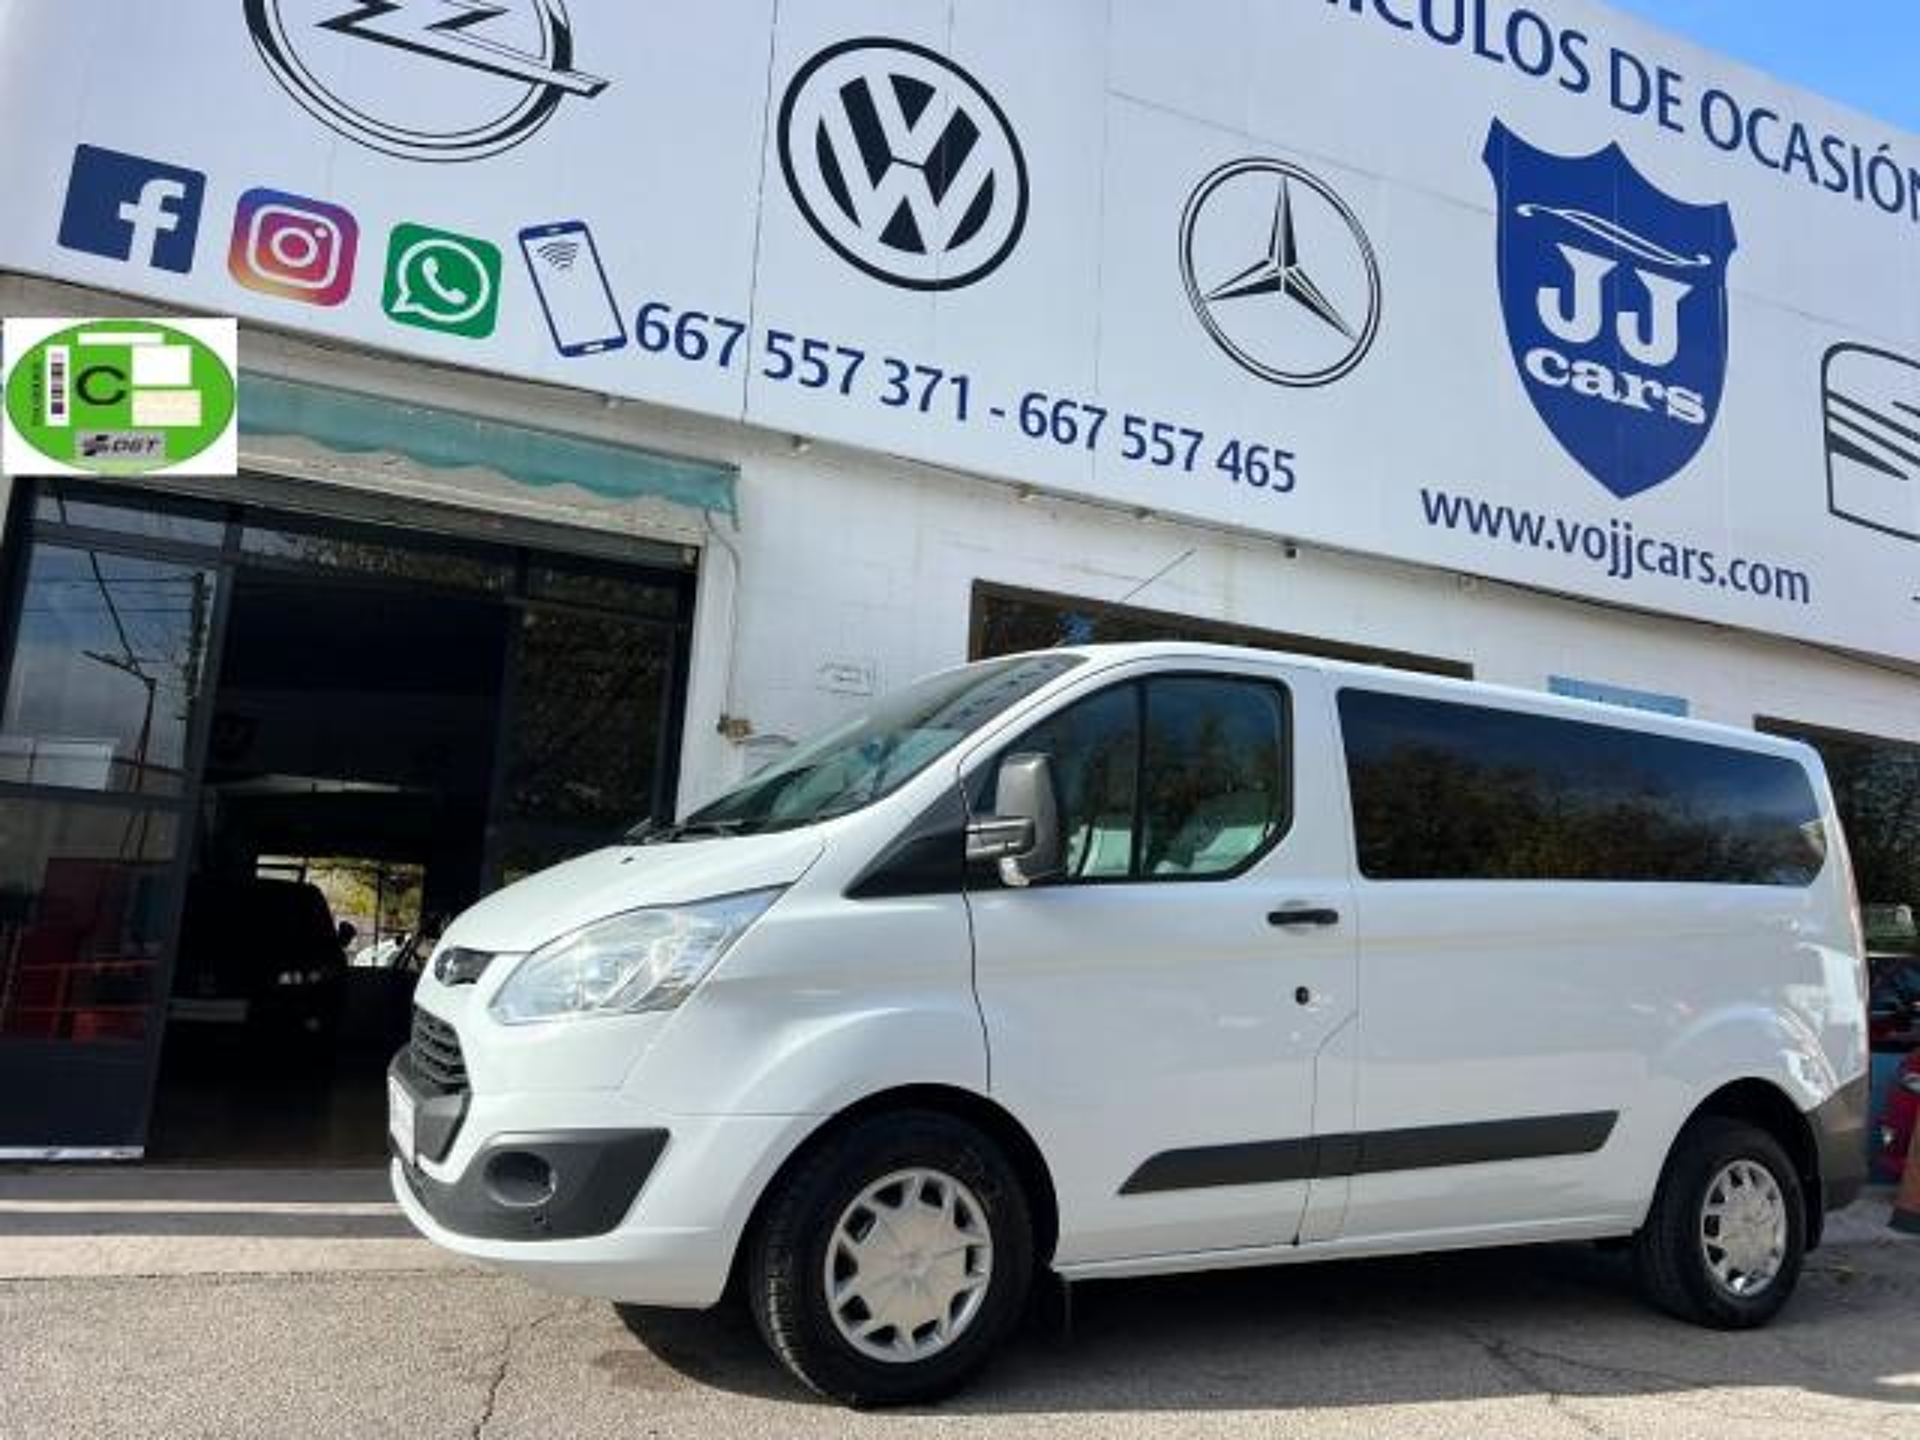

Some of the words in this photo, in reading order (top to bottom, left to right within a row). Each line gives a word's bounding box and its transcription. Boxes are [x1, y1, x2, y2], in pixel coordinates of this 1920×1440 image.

[1610, 47, 1685, 133] DE
[1536, 242, 1693, 367] JJ
[635, 302, 746, 367] 667
[763, 329, 865, 395] 557
[880, 358, 969, 421] 371
[1019, 392, 1108, 450] 667
[1121, 414, 1204, 472] 557
[1216, 440, 1295, 493] 465
[1524, 347, 1706, 424] cars
[1420, 488, 1810, 605] www.vojjcars.com
